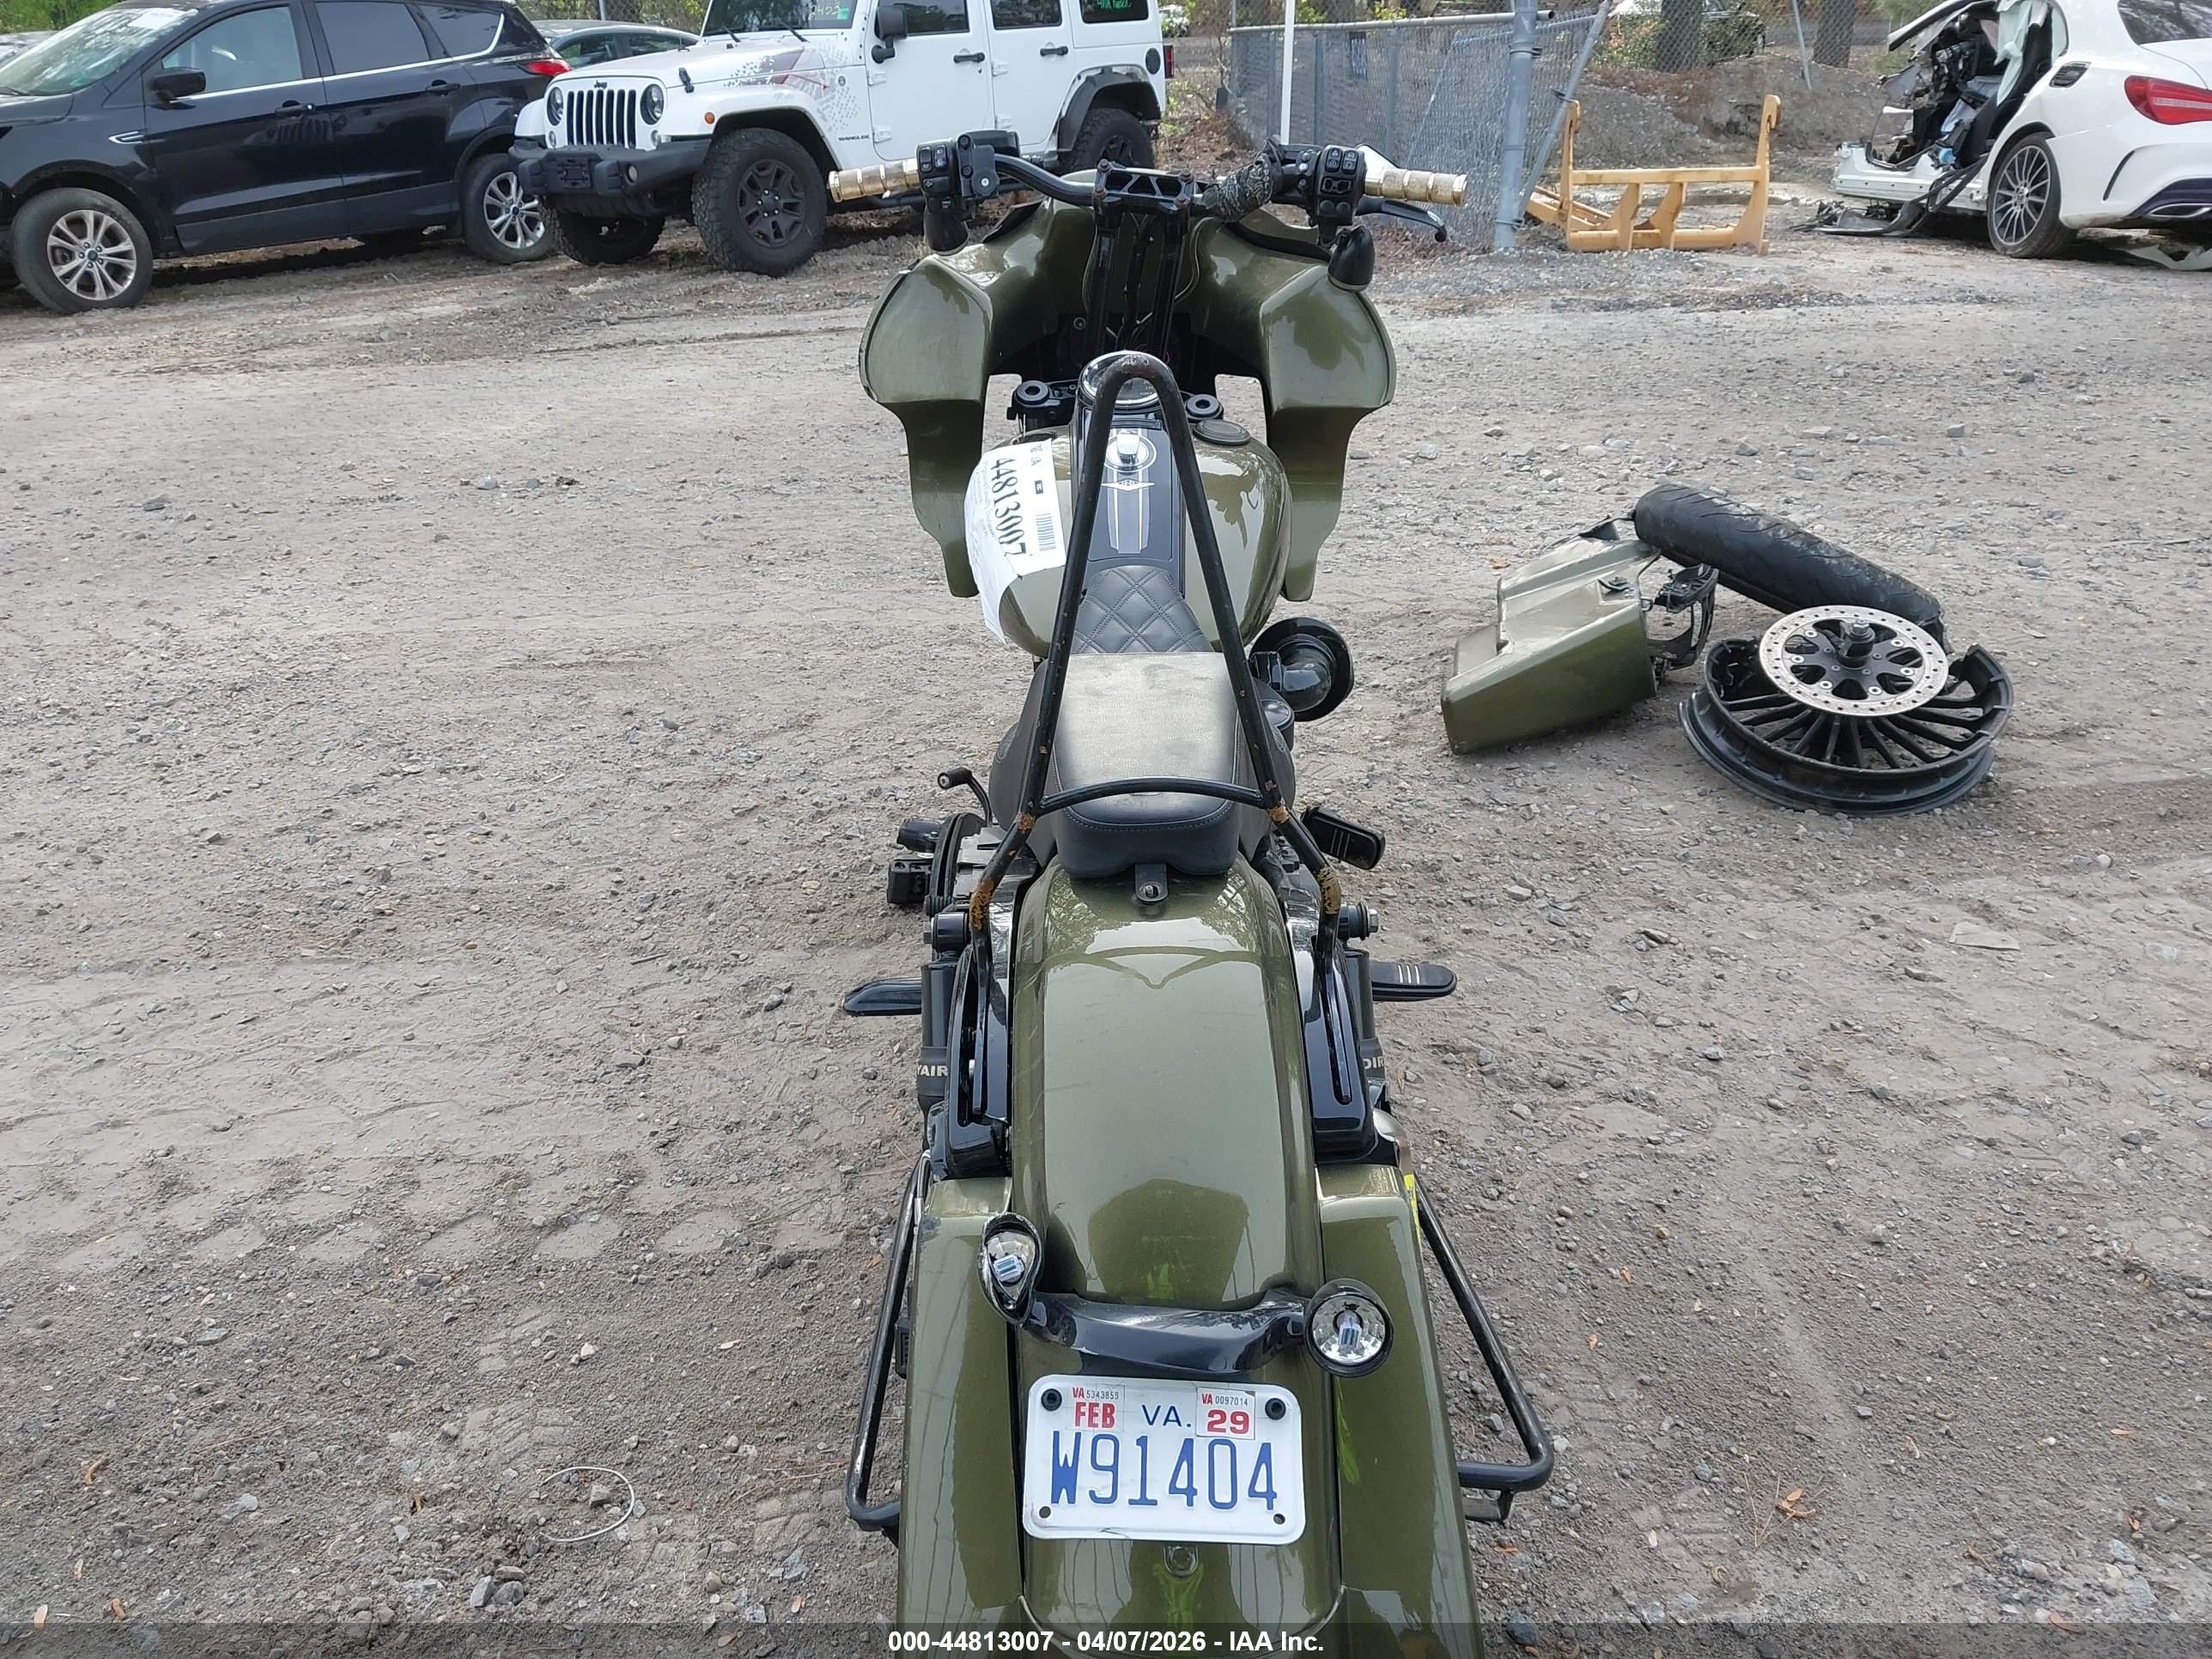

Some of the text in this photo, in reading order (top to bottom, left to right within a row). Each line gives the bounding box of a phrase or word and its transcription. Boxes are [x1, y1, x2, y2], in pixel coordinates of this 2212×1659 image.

[989, 457, 1027, 557] 44813007
[1072, 1387, 1085, 1399] VA
[1201, 1393, 1249, 1407] VA 0097014
[1074, 1401, 1115, 1429] FEB
[1141, 1404, 1192, 1428] VA.
[1206, 1409, 1249, 1435] 29
[1050, 1430, 1278, 1511] W91404
